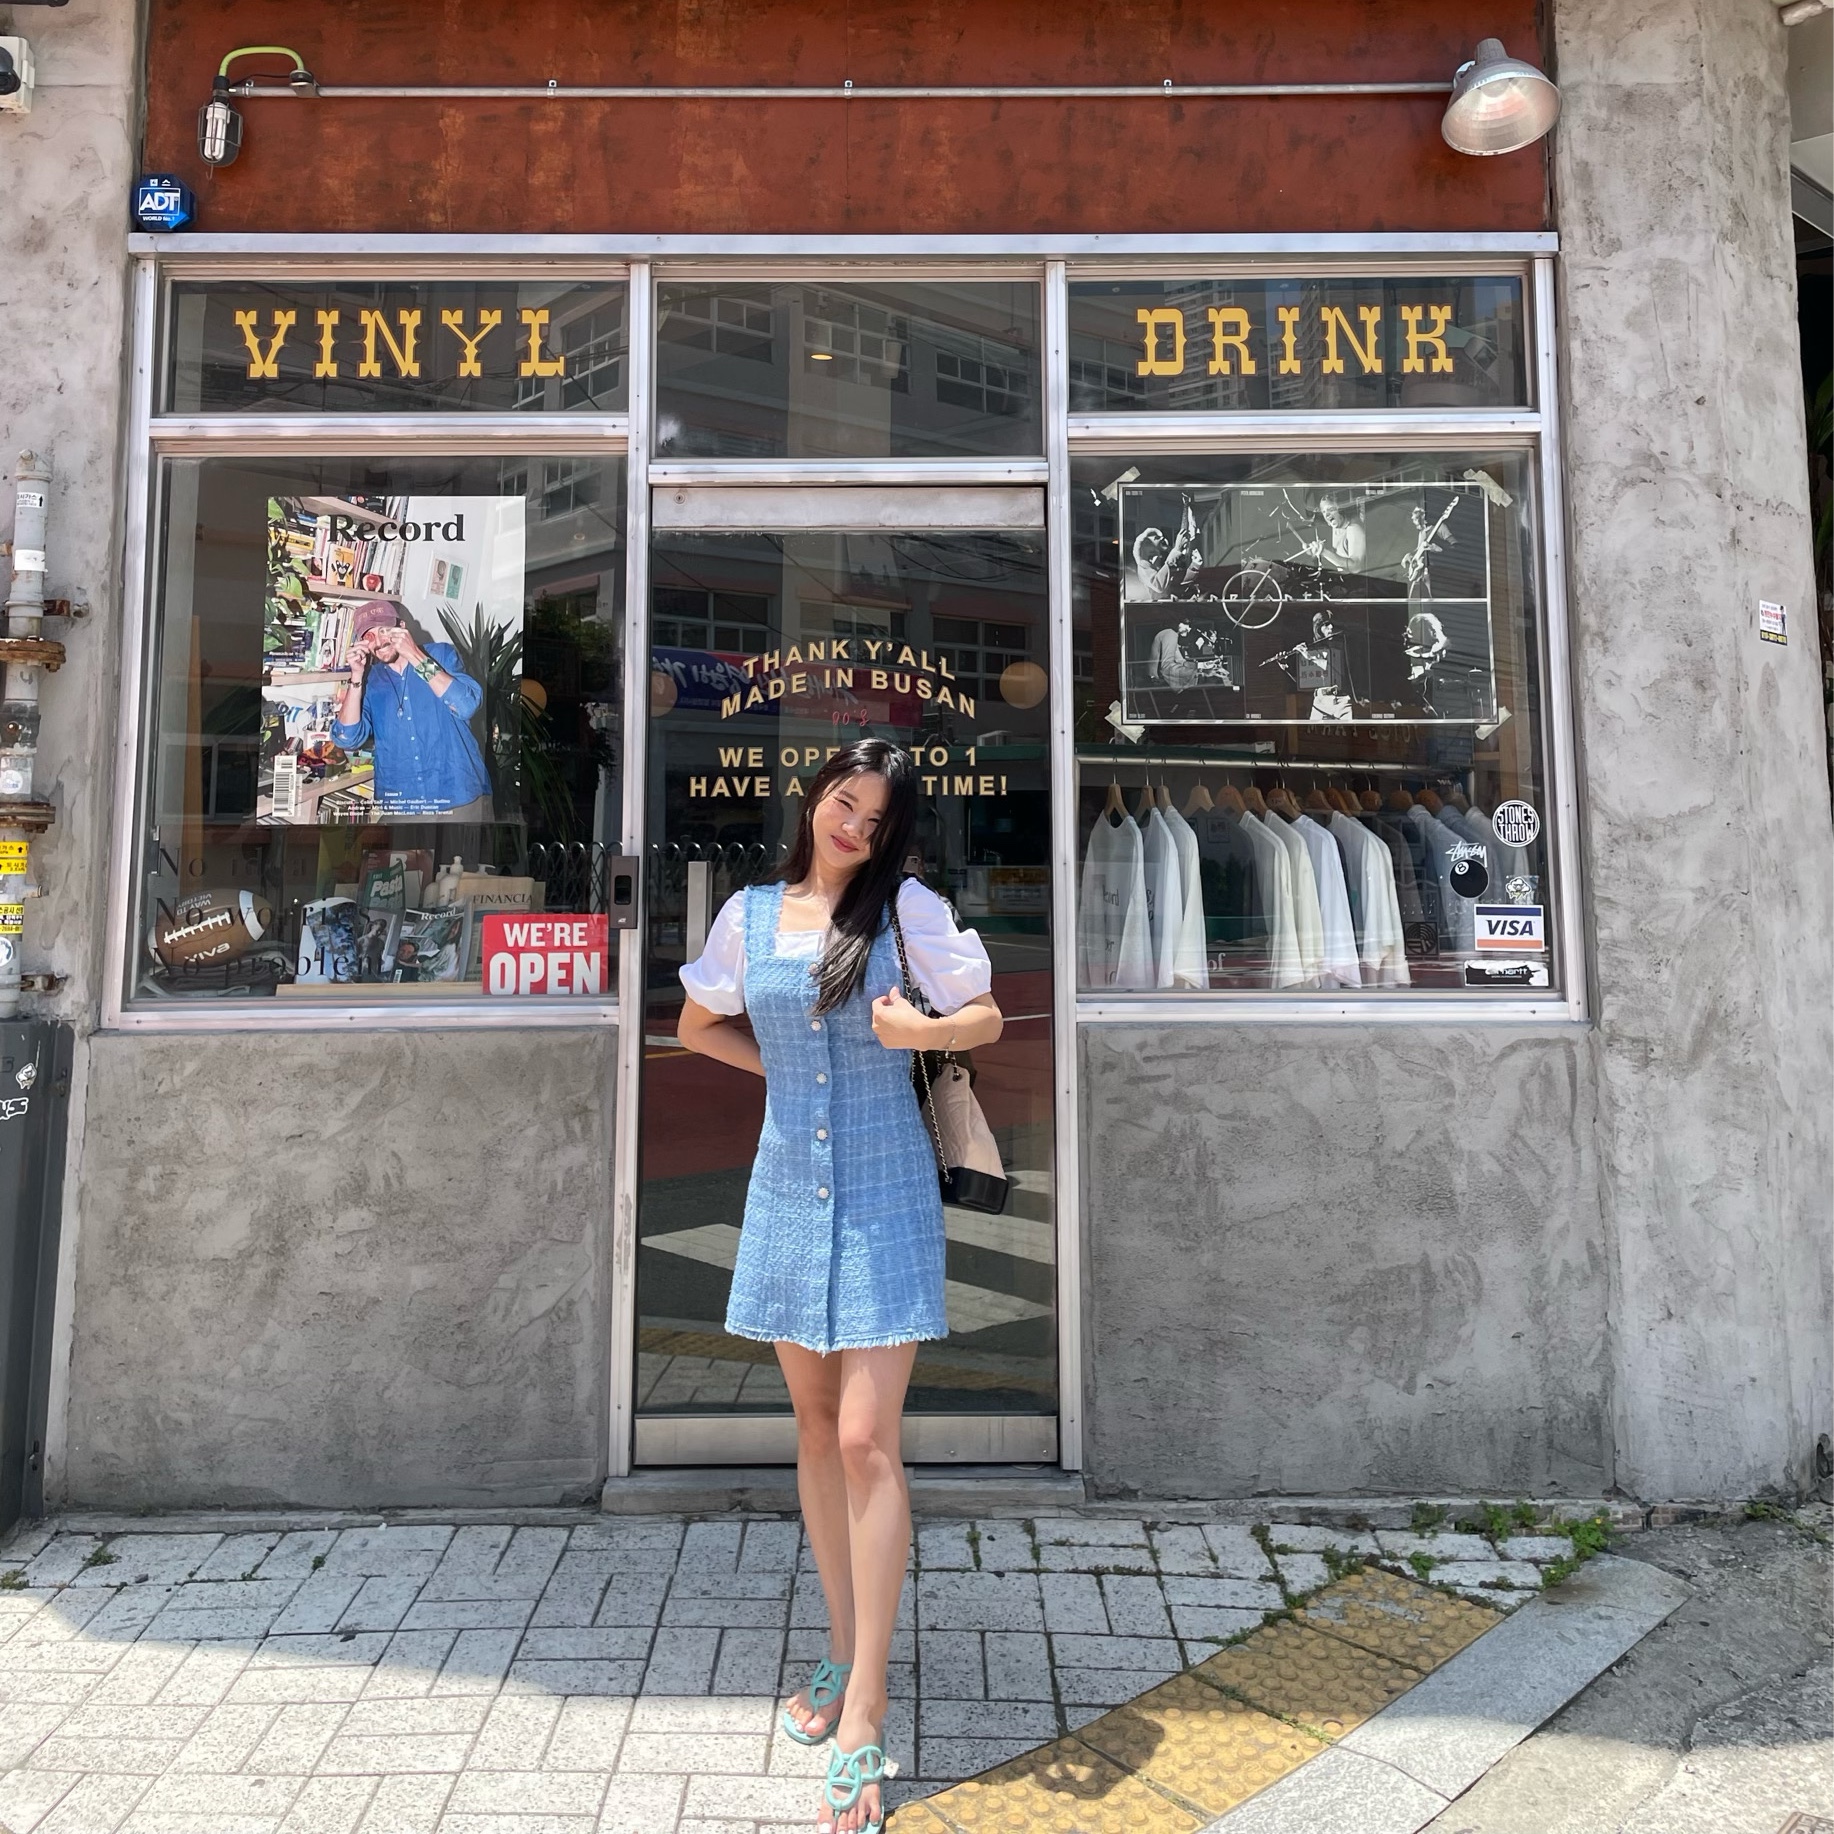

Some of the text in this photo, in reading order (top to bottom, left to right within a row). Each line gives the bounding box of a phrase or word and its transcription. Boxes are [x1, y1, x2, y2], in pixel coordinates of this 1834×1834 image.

[140, 192, 180, 211] ADT
[232, 308, 567, 378] VINYL
[1136, 305, 1455, 376] DRINK
[326, 514, 466, 542] Record
[743, 639, 956, 682] THANK Y'ALL
[721, 668, 976, 719] MADE IN BUSAN
[718, 746, 977, 767] WE OPE TO 1
[689, 775, 1008, 797] HAVE A TIME!
[1497, 805, 1535, 825] STONES
[1498, 823, 1535, 843] THROW
[158, 848, 206, 877] No
[1457, 863, 1467, 873] 8
[370, 875, 403, 897] Pasta
[155, 897, 204, 927] No
[420, 907, 456, 921] Record
[503, 922, 588, 947] WE'RE
[1485, 919, 1535, 936] VISA
[151, 947, 200, 977] No
[489, 952, 601, 995] OPEN
